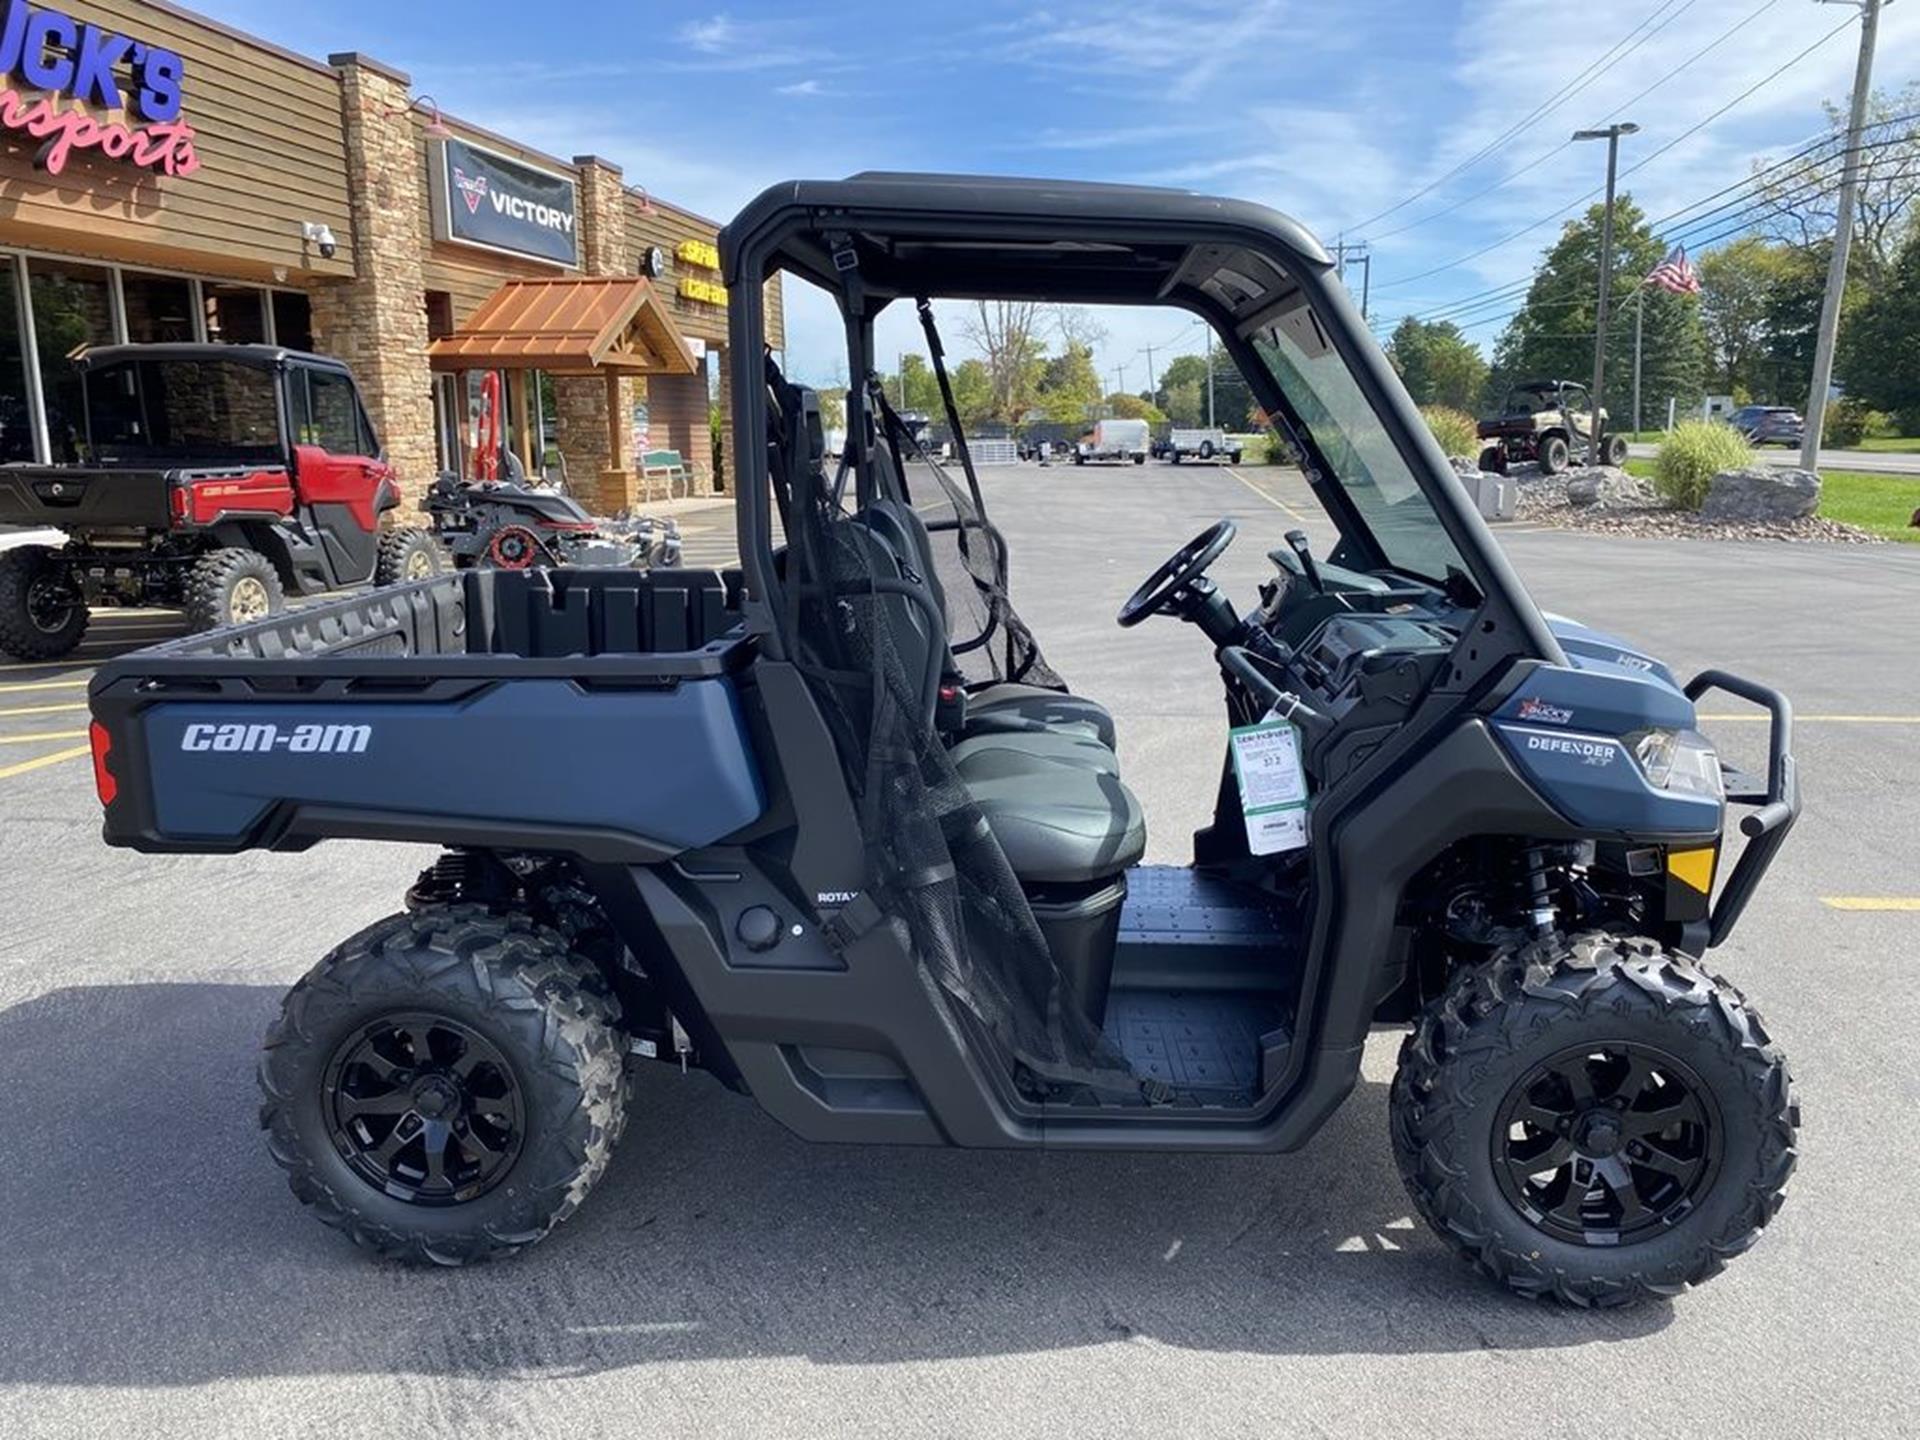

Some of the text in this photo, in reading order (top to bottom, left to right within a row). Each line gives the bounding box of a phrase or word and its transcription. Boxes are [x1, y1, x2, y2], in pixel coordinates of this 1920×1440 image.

[490, 189, 573, 233] VICTORY
[181, 724, 372, 752] can-am
[1528, 737, 1615, 758] DEFENDER
